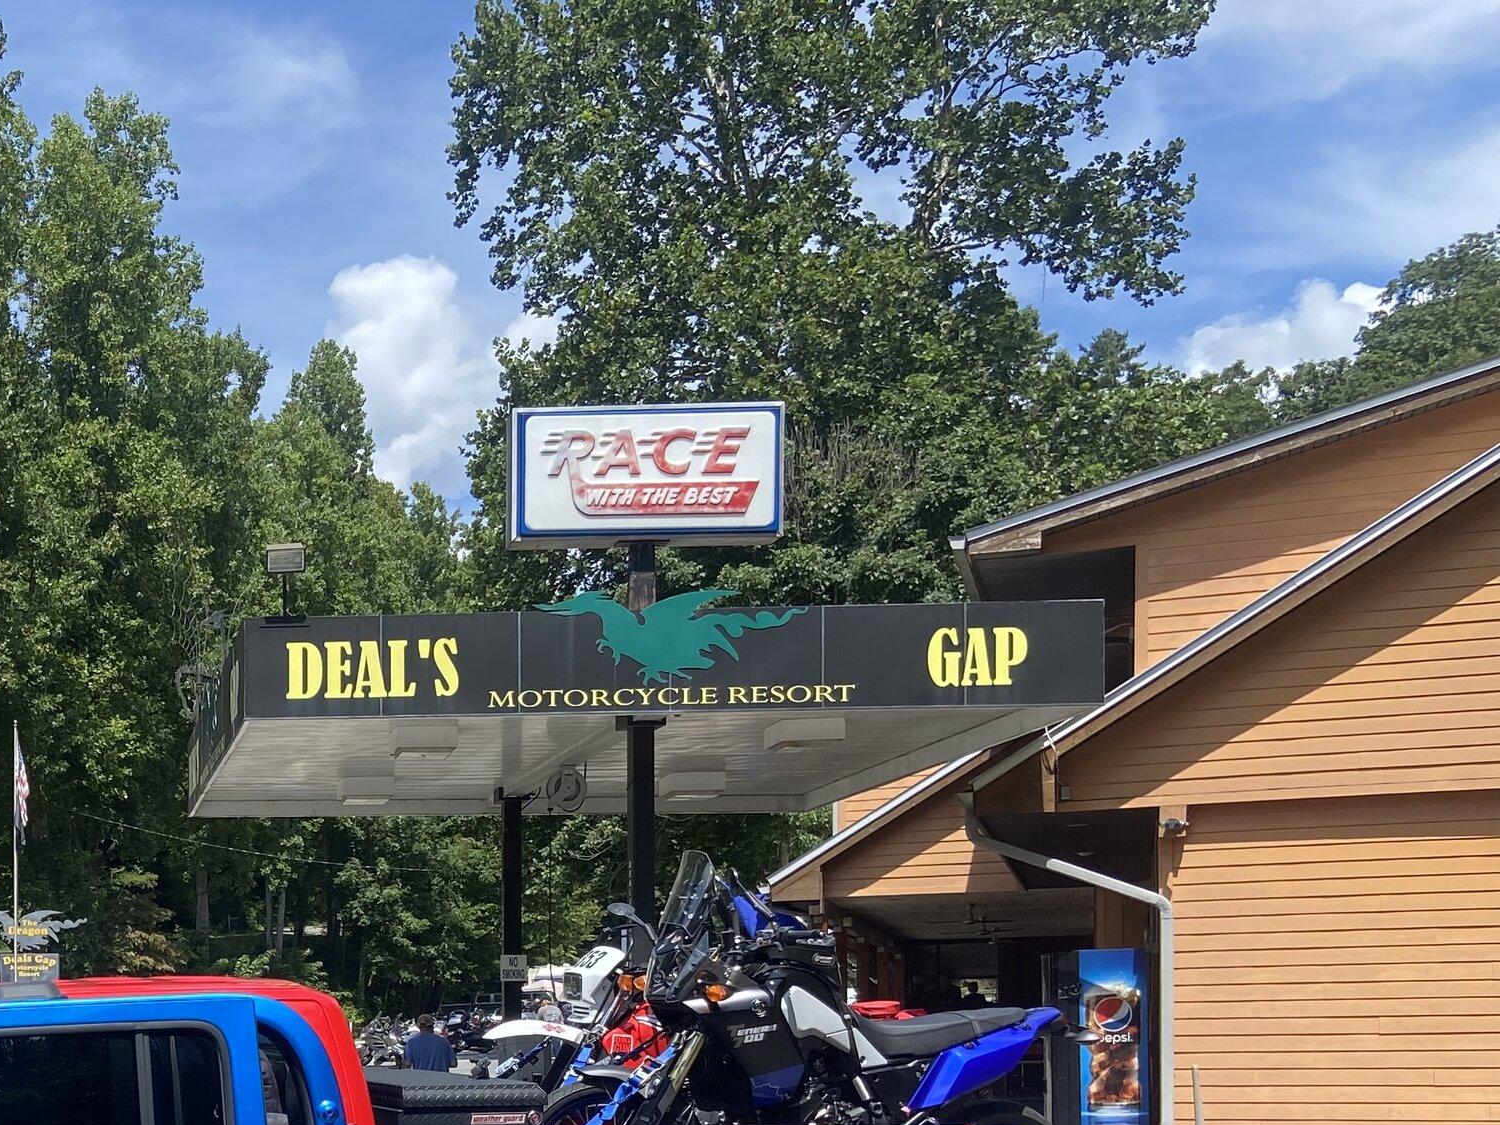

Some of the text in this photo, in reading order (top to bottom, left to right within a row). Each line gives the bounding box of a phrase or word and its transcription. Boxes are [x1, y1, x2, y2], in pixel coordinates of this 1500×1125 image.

[541, 426, 751, 477] RACE
[586, 485, 740, 507] WITH THE BEST
[285, 637, 460, 700] DEAL'S
[927, 626, 1029, 688] GAP
[487, 683, 857, 709] MOTORCYCLE RESORT
[501, 968, 526, 980] SMOKING
[508, 956, 519, 968] NO
